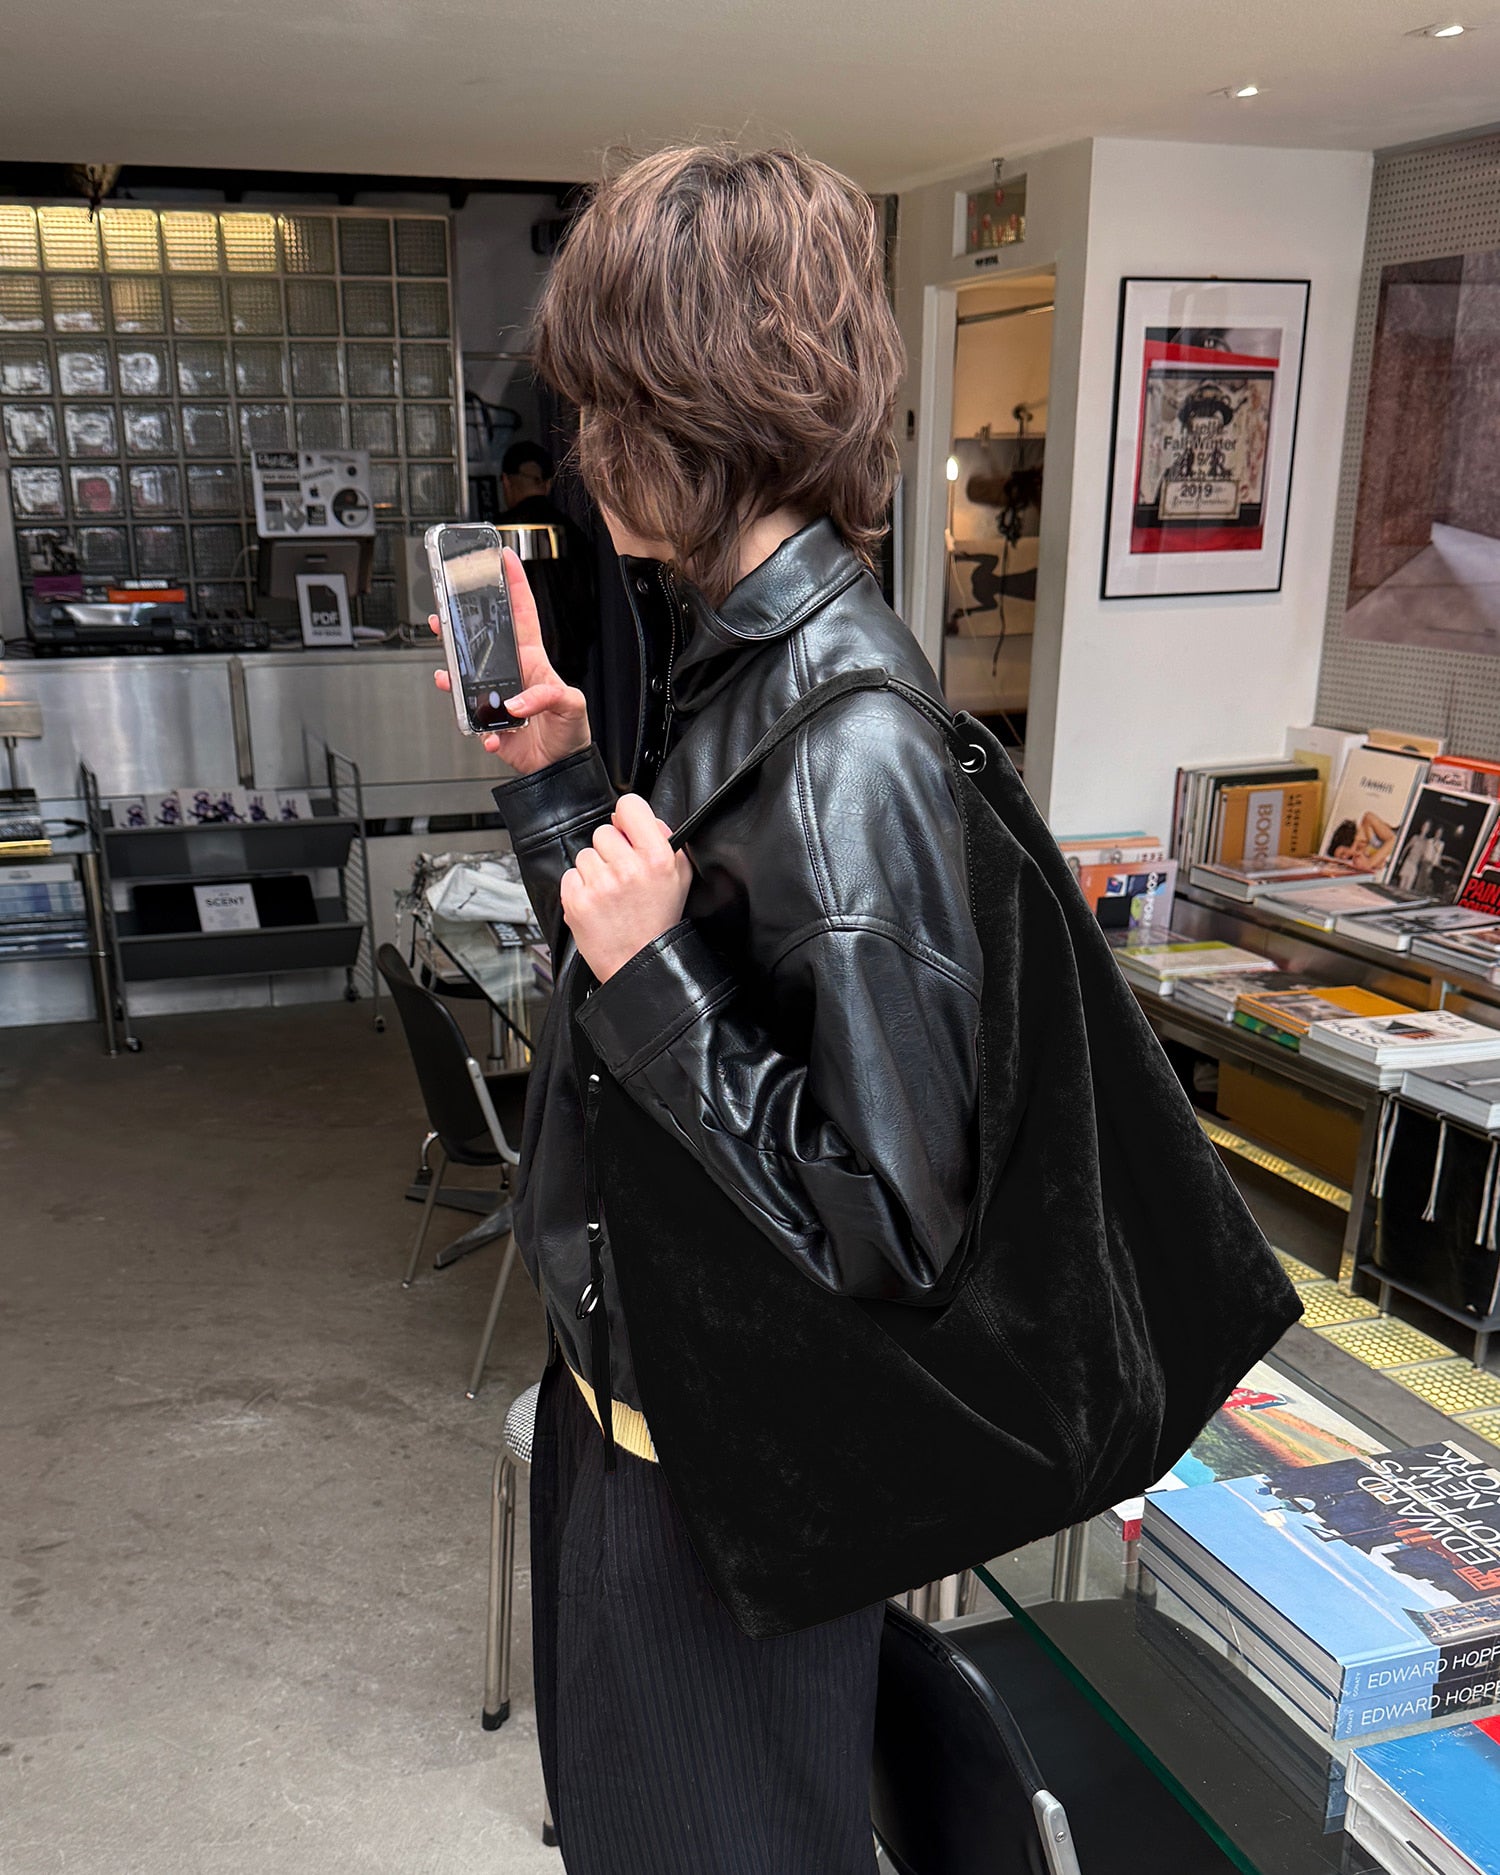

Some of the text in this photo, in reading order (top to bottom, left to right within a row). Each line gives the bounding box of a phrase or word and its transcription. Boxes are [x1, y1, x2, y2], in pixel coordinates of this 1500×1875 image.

[1181, 483, 1213, 498] 2019
[312, 612, 338, 625] PDF
[206, 896, 244, 908] SCENT
[1462, 878, 1500, 908] PAIN
[1409, 1466, 1495, 1510] NEW
[1357, 1477, 1497, 1565] EDWARD
[1367, 1658, 1447, 1689] EDWARD
[1361, 1694, 1441, 1726] EDWARD
